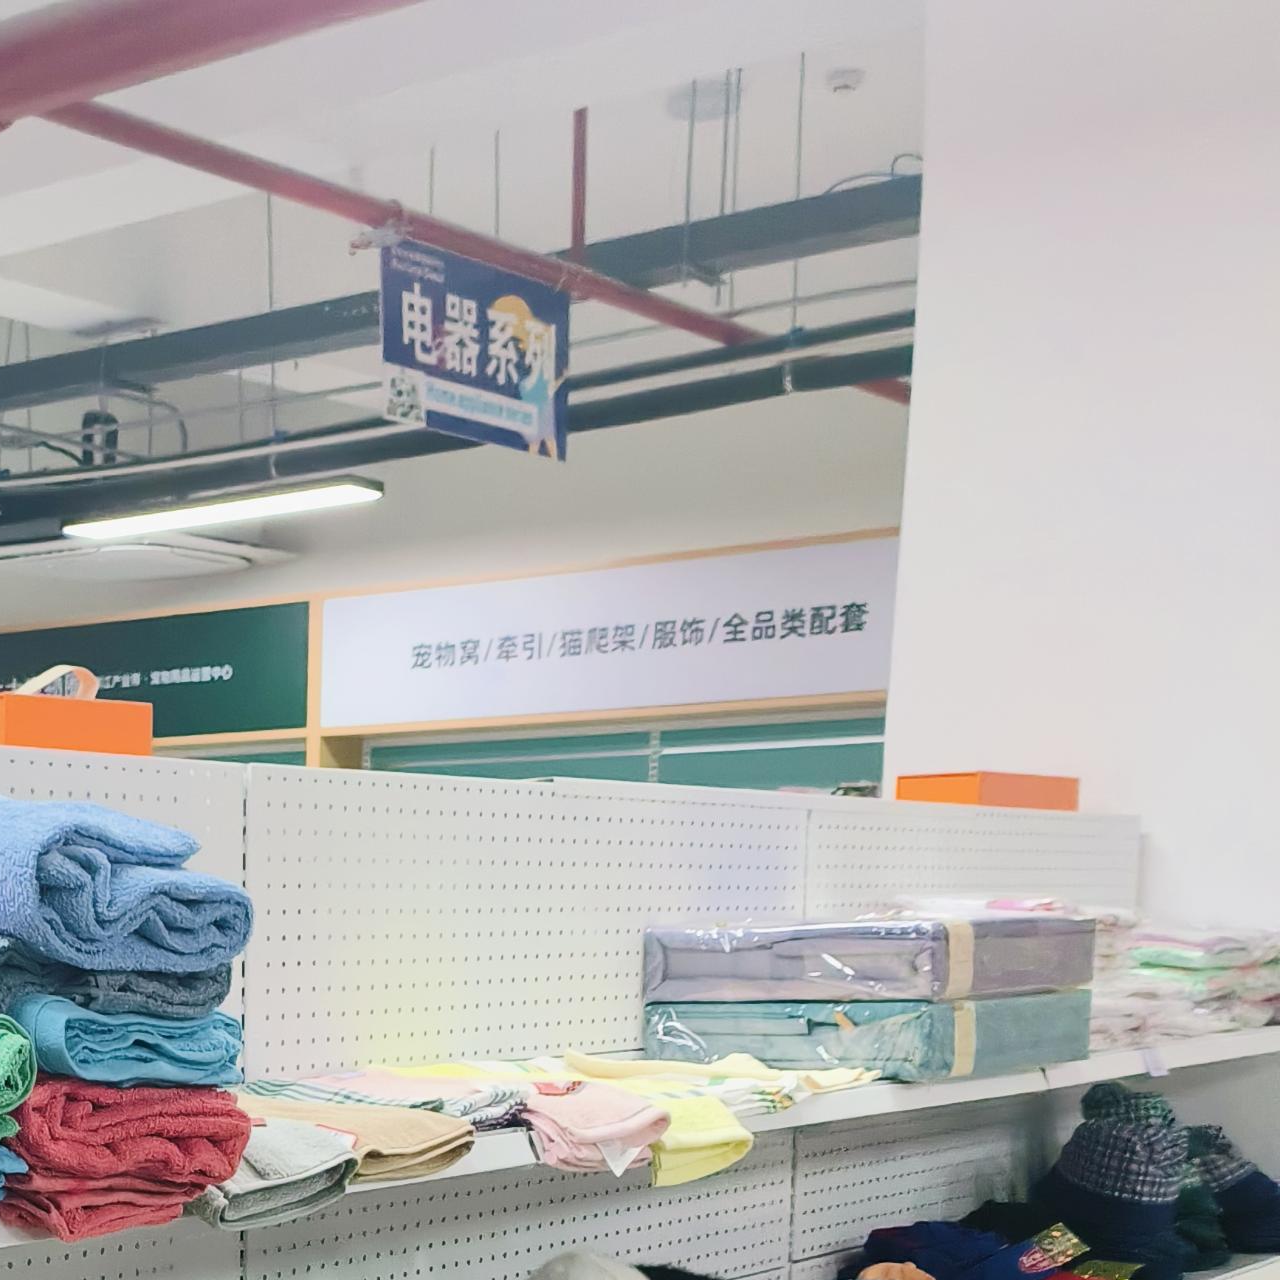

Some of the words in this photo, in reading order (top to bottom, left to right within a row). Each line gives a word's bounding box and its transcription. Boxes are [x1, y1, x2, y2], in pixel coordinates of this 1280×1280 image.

[401, 282, 556, 391] 电器系列
[412, 602, 869, 669] 宠物窝/牵引/猫爬架/服饰/全品类配套
